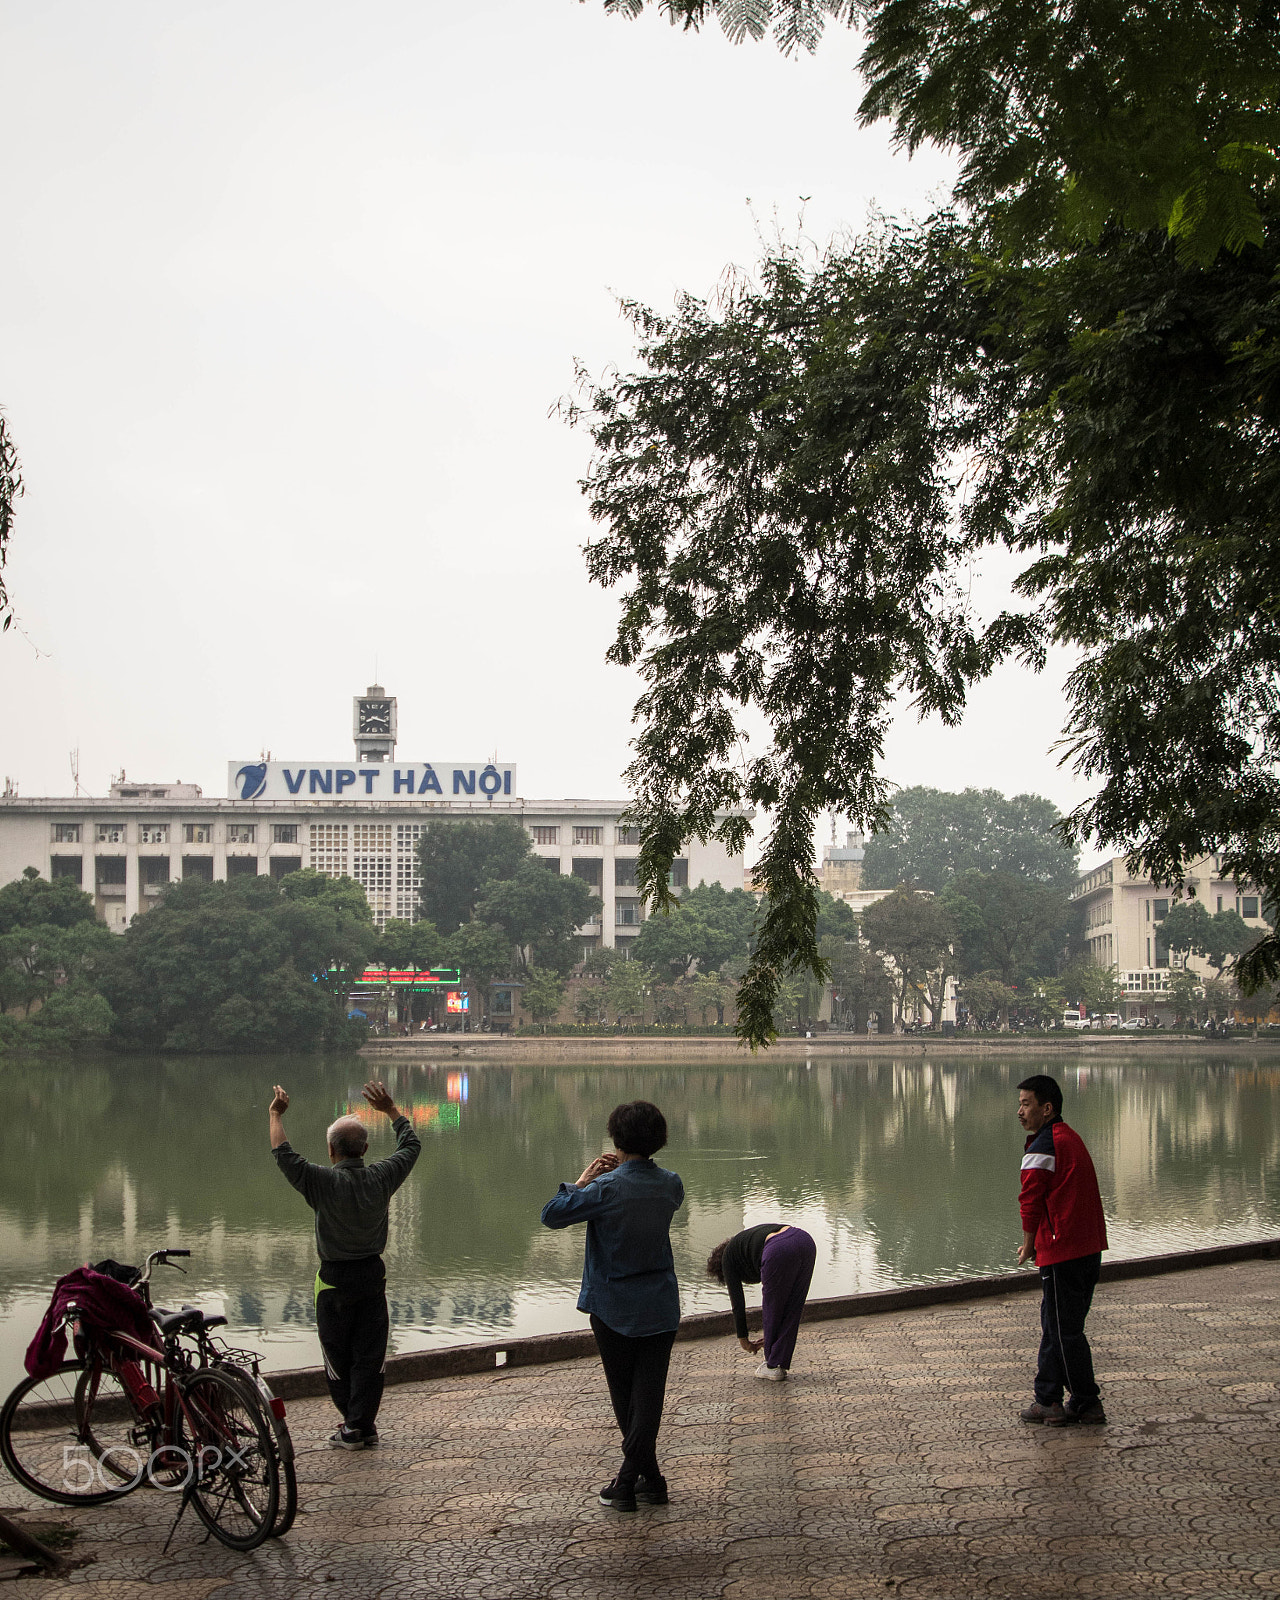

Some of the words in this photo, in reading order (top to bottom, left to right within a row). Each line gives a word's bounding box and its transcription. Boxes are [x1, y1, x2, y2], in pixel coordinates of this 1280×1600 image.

[282, 769, 380, 794] VNPT
[393, 763, 443, 795] HÀ
[453, 764, 511, 800] NỘI
